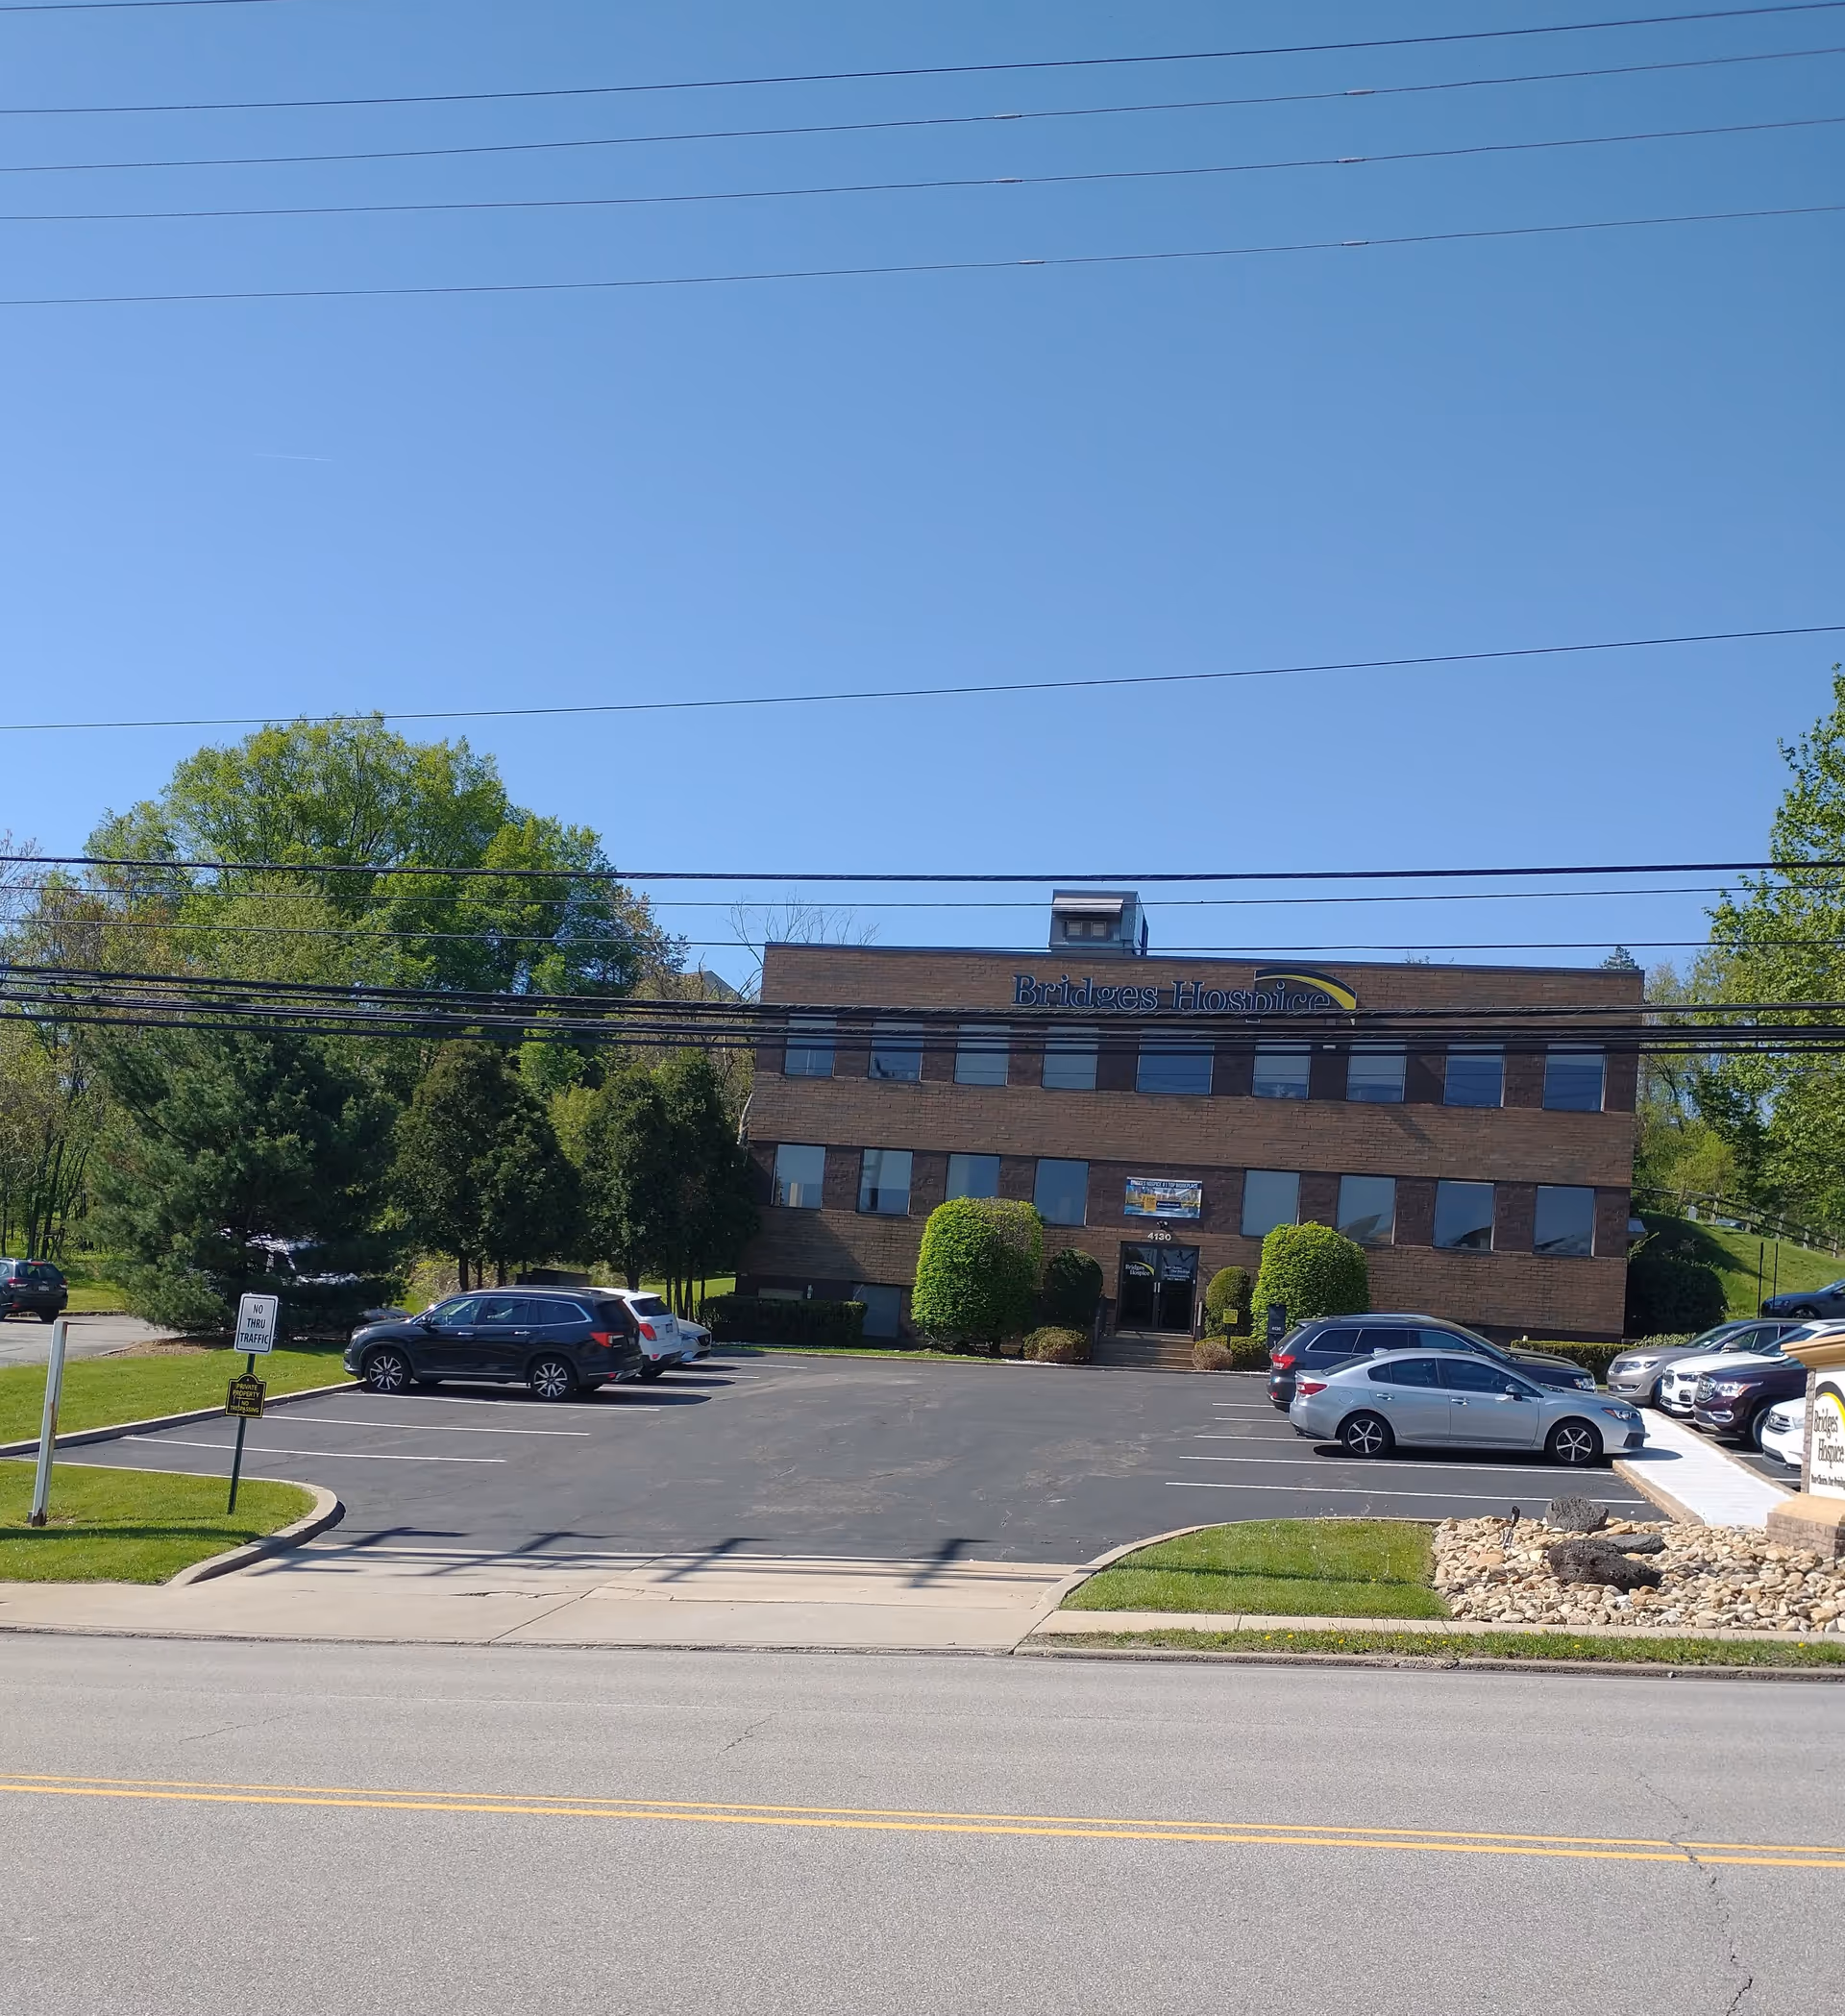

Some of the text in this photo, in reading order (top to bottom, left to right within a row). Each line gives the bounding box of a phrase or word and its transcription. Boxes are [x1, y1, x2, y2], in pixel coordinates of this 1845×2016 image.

[1011, 973, 1331, 1014] Bridges Hospice
[1147, 1232, 1171, 1242] 4130
[253, 1304, 264, 1315] NO
[247, 1317, 266, 1329] THRU
[240, 1332, 269, 1344] TRAFFIC
[232, 1389, 260, 1398] PROPERTY
[1813, 1408, 1838, 1439] Bridges
[1818, 1438, 1845, 1469] Hospice
